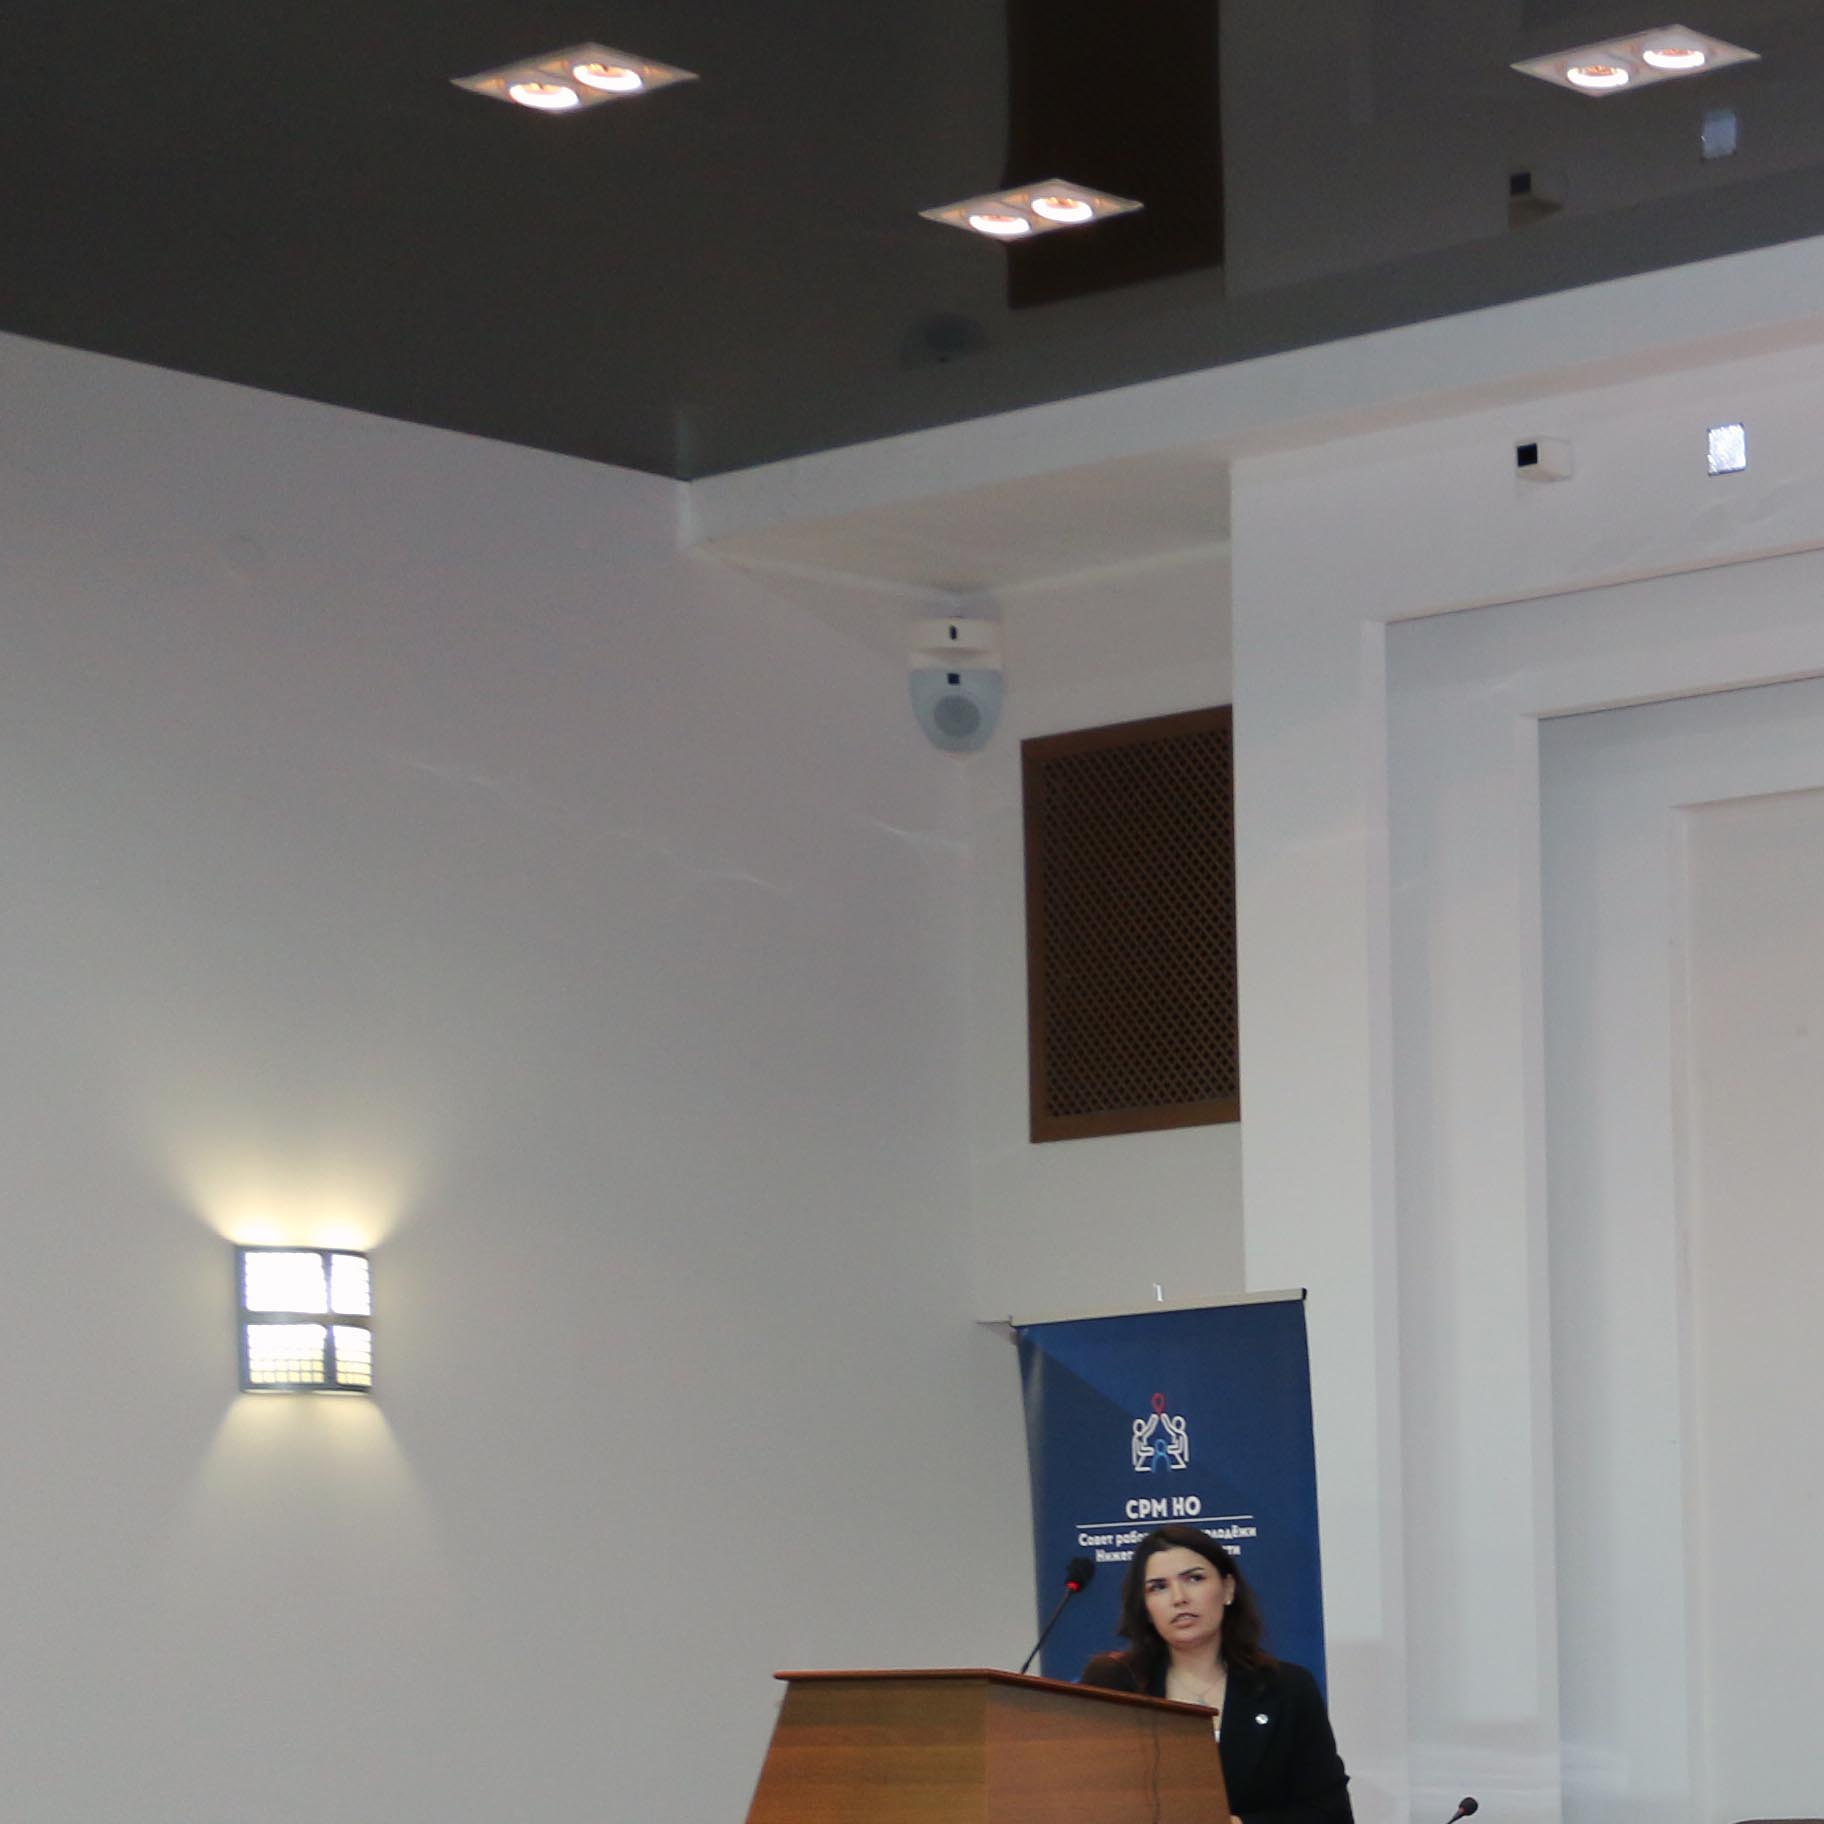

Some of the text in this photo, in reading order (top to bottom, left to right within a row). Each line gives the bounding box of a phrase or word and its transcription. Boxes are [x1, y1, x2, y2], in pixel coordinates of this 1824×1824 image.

[1126, 1495, 1201, 1519] СРМ НО
[1078, 1533, 1113, 1546] Совет
